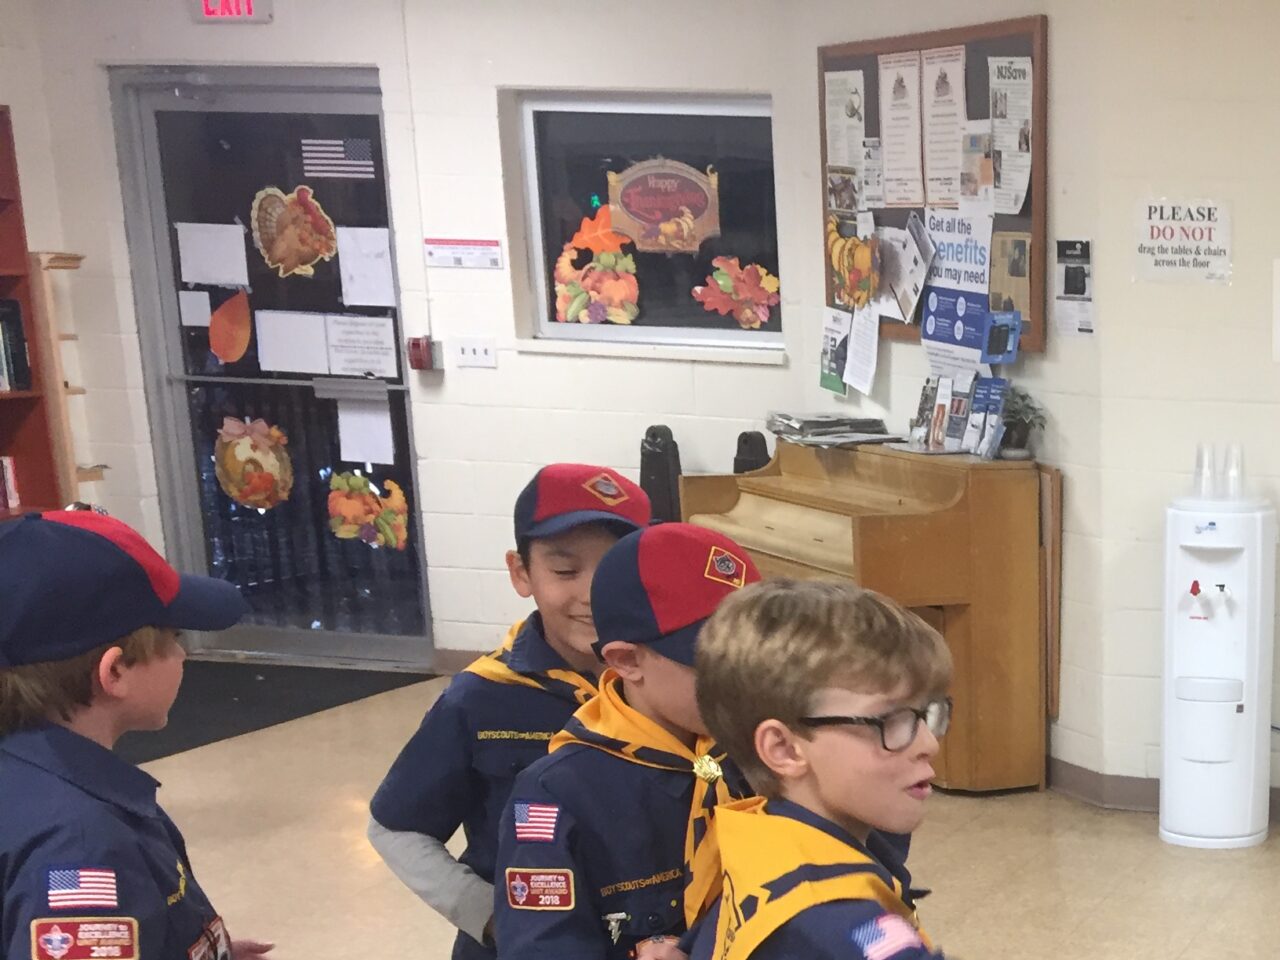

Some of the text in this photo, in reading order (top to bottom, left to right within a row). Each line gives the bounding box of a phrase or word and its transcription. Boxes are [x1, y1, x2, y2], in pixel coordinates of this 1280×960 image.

[1147, 205, 1218, 222] PLEASE
[929, 215, 972, 235] Get all the
[1149, 225, 1216, 242] DO NOT
[1138, 243, 1227, 257] drag the tables & chairs
[1153, 257, 1211, 269] across the floor
[944, 267, 963, 285] may
[963, 269, 988, 285] need.
[538, 894, 561, 905] 2018
